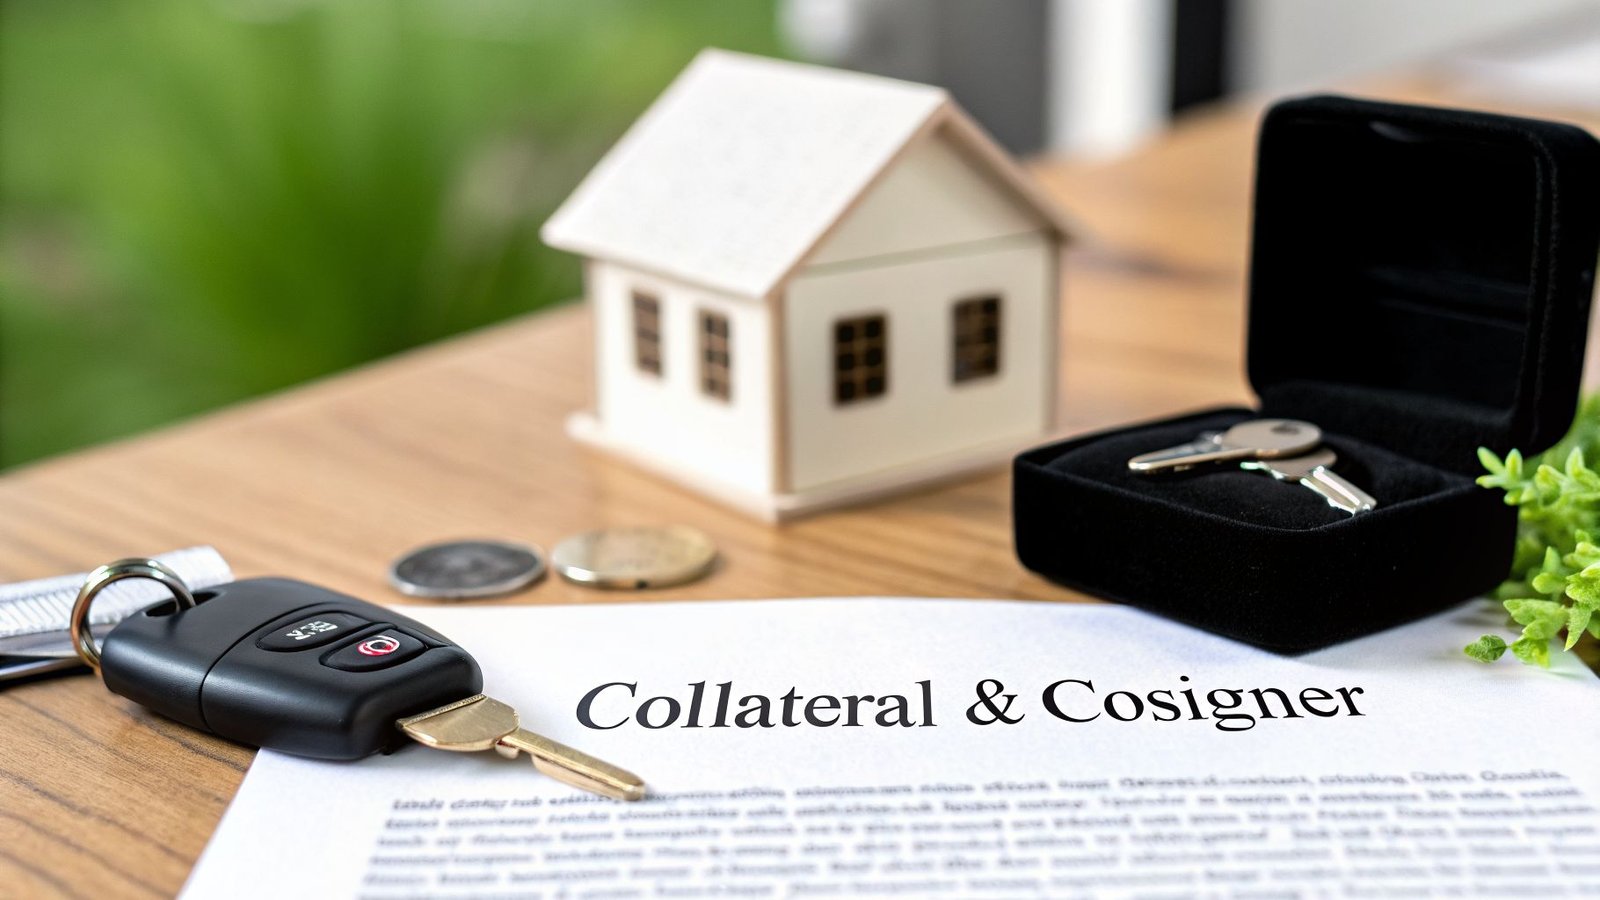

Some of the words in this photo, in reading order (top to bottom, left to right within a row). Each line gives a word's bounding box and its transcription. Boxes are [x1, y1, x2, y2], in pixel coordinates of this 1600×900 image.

[576, 679, 938, 730] Collateral
[965, 679, 1026, 726] &
[1041, 675, 1365, 732] Cosigner
